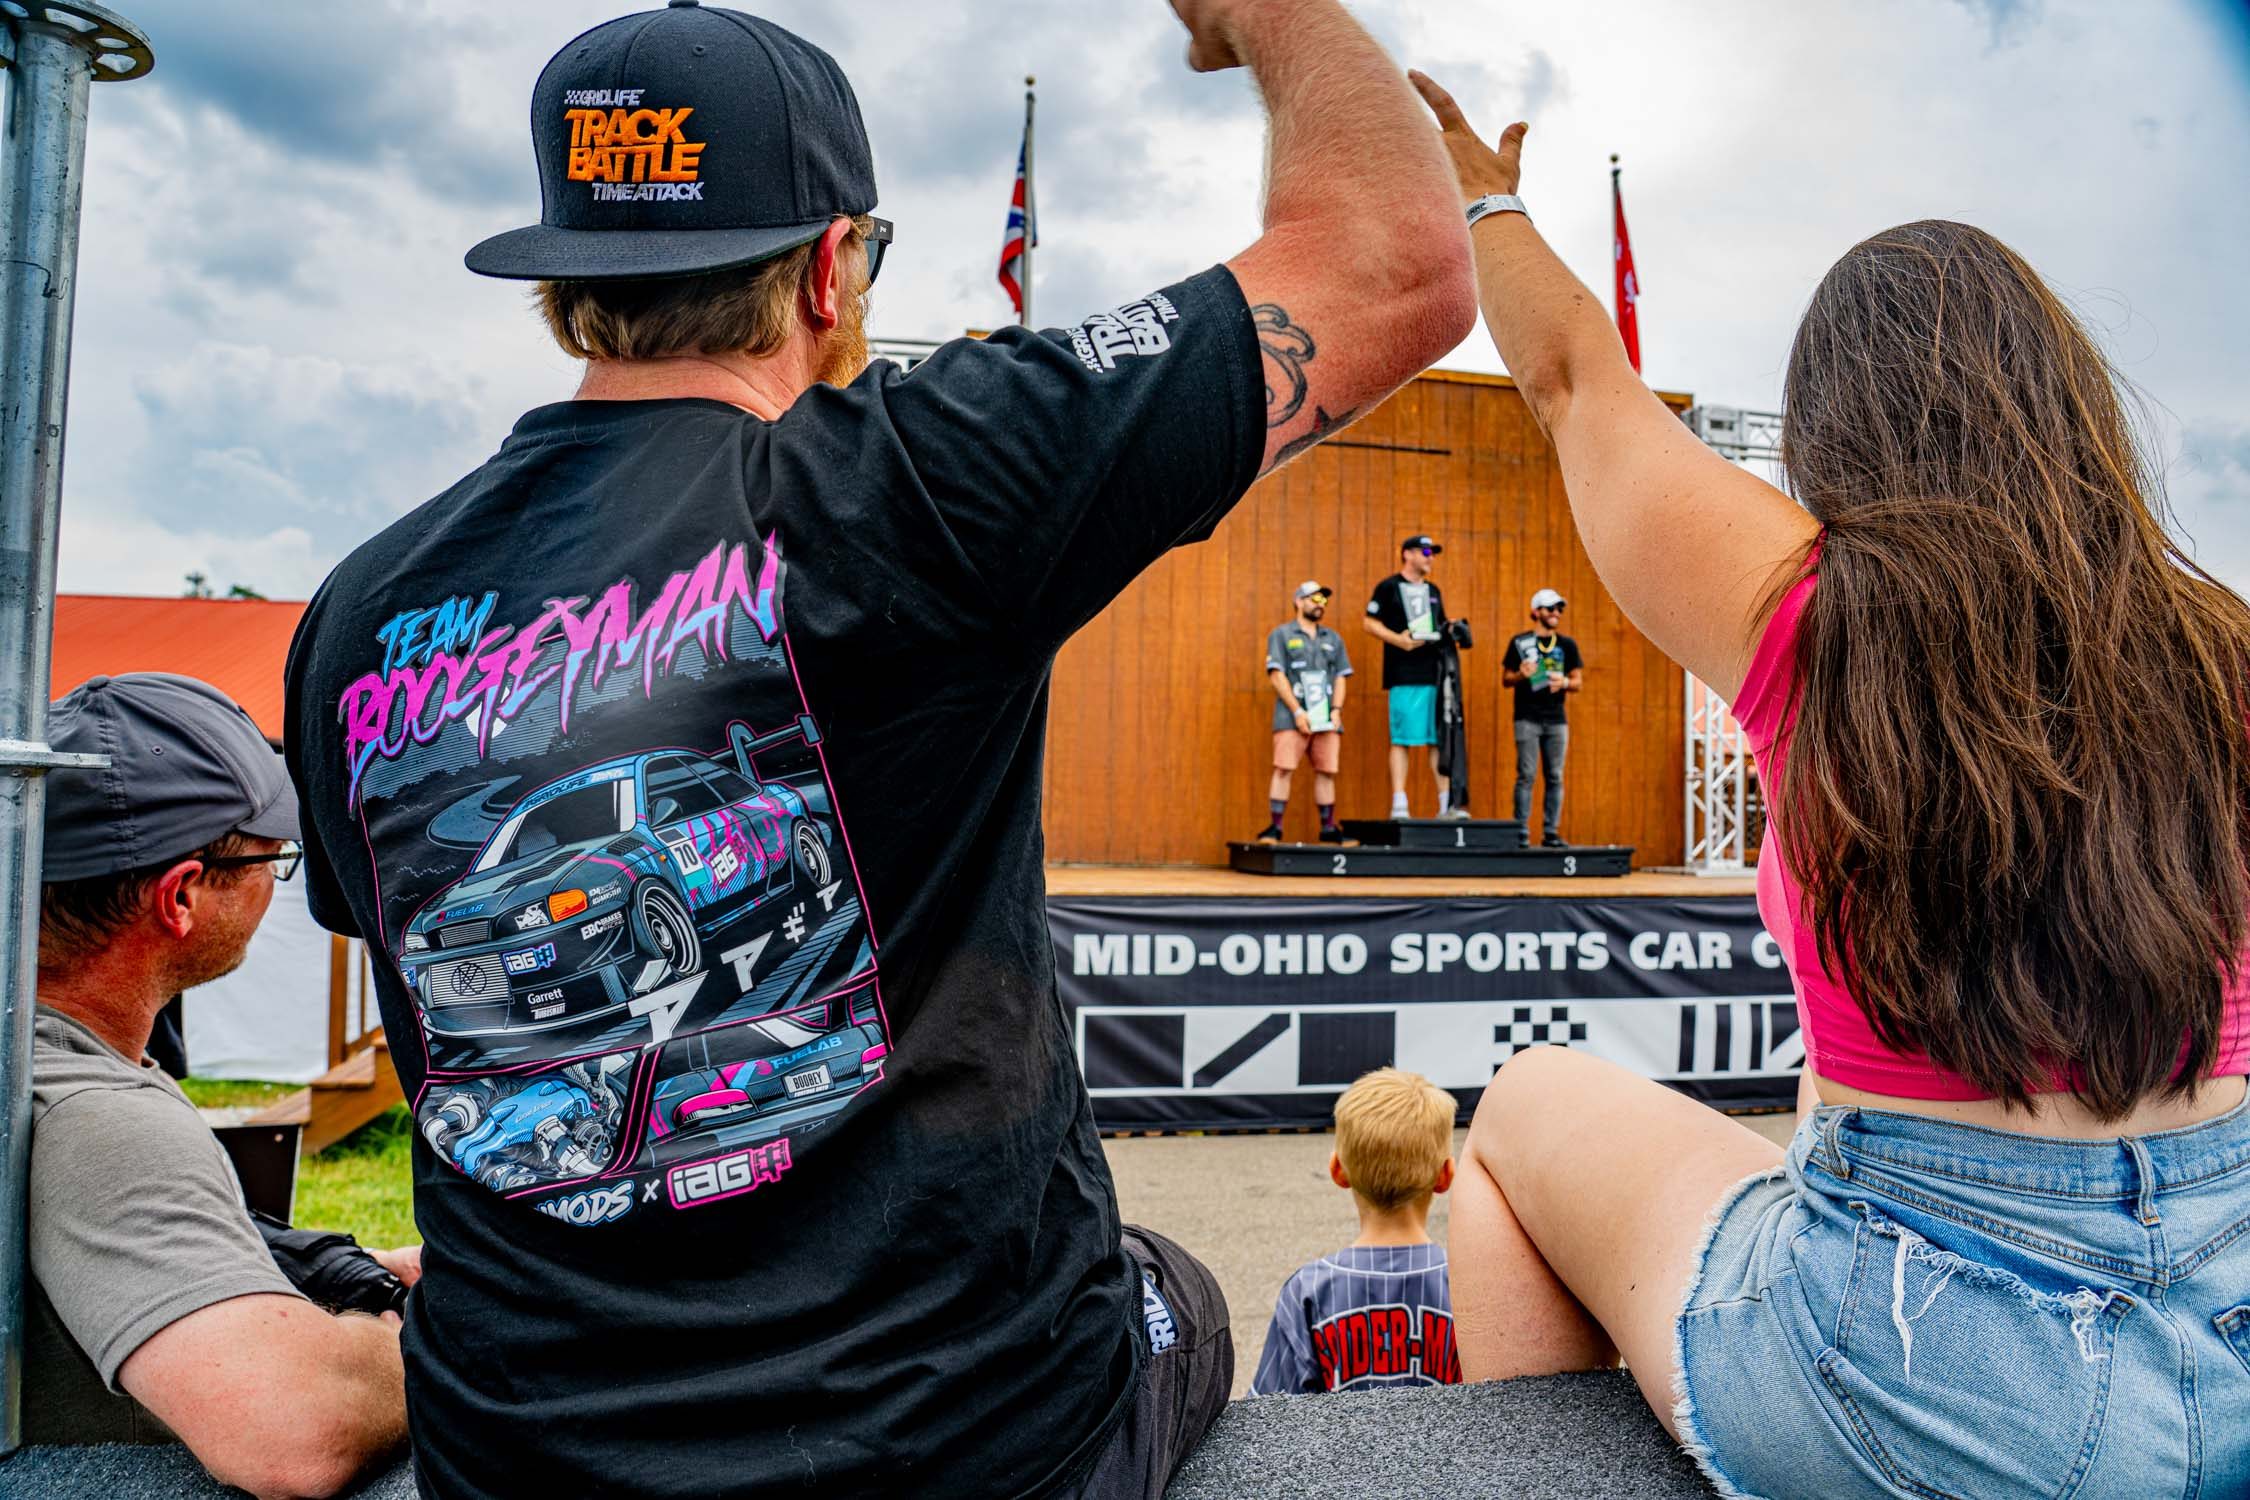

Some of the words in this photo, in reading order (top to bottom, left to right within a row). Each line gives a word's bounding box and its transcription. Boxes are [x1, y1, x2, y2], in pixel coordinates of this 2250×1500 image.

[579, 89, 645, 106] GRIDLIFE
[564, 108, 694, 147] TRACK
[568, 143, 707, 182] BATTLE
[592, 183, 637, 201] TIME
[632, 182, 704, 201] ATTACK
[376, 591, 499, 682] TEAM
[338, 527, 783, 814] BOOGEYMAN
[1455, 827, 1466, 847] 1
[675, 843, 699, 869] 70
[1332, 854, 1347, 875] 2
[1563, 855, 1577, 876] 3
[445, 903, 485, 919] FUELAB
[580, 920, 604, 940] EBC
[1073, 933, 1368, 976] MID-OHIO
[1390, 931, 1610, 974] SPORTS
[1629, 930, 1733, 970] CAR
[527, 988, 564, 1004] Garrett
[770, 1036, 843, 1070] FUELAB
[541, 1182, 633, 1224] MODS
